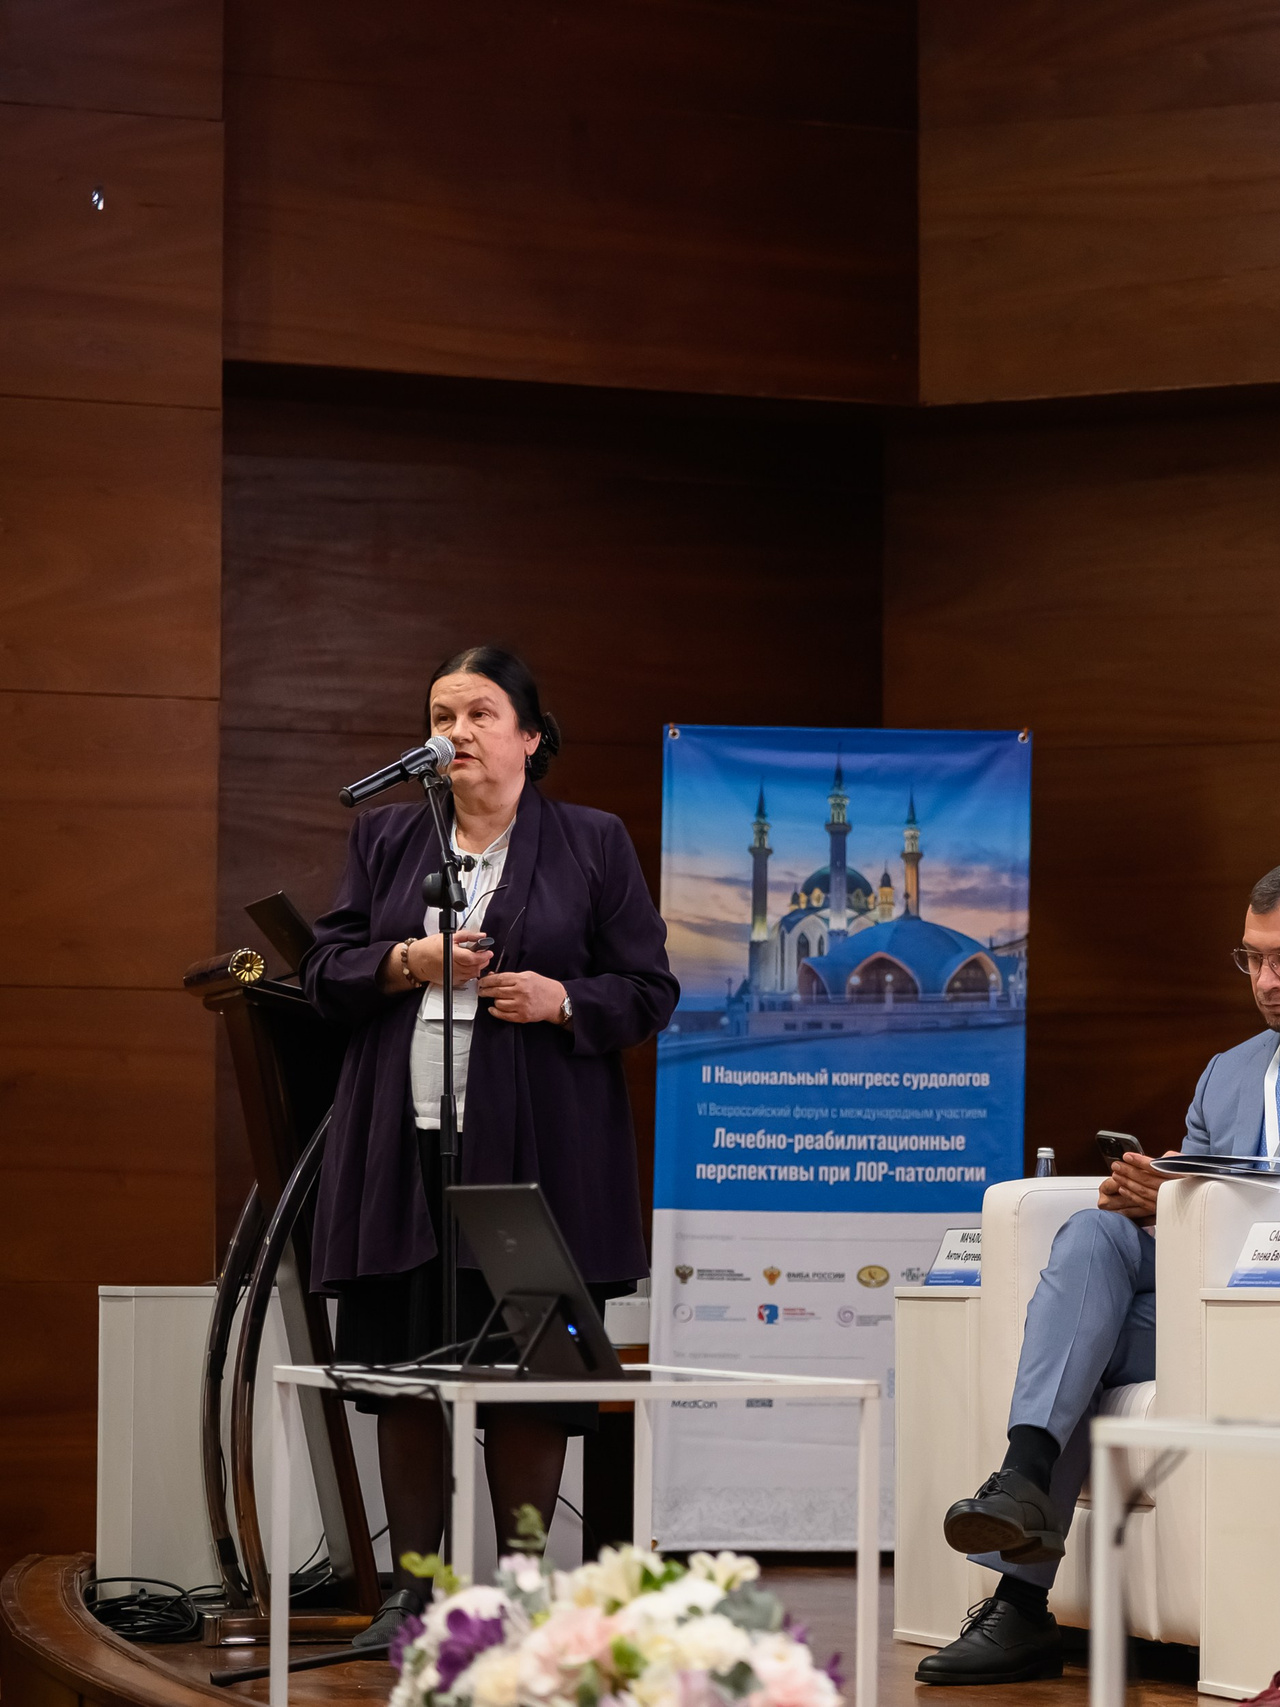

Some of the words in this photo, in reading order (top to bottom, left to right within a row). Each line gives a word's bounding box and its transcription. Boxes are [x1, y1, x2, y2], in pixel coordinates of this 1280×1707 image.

[714, 1065, 829, 1087] Национальный
[831, 1072, 900, 1090] конгресс
[902, 1072, 991, 1091] сурдологов
[708, 1102, 791, 1118] Всероссийский
[792, 1105, 829, 1121] форум
[830, 1107, 839, 1119] с
[839, 1107, 933, 1121] международным
[934, 1108, 988, 1122] участием
[712, 1127, 966, 1154] Лечебно-реабилитационные
[695, 1163, 815, 1184] перспективы
[818, 1164, 851, 1186] при
[854, 1161, 987, 1184] ЛОР-патологии
[1251, 1249, 1271, 1261] Елена
